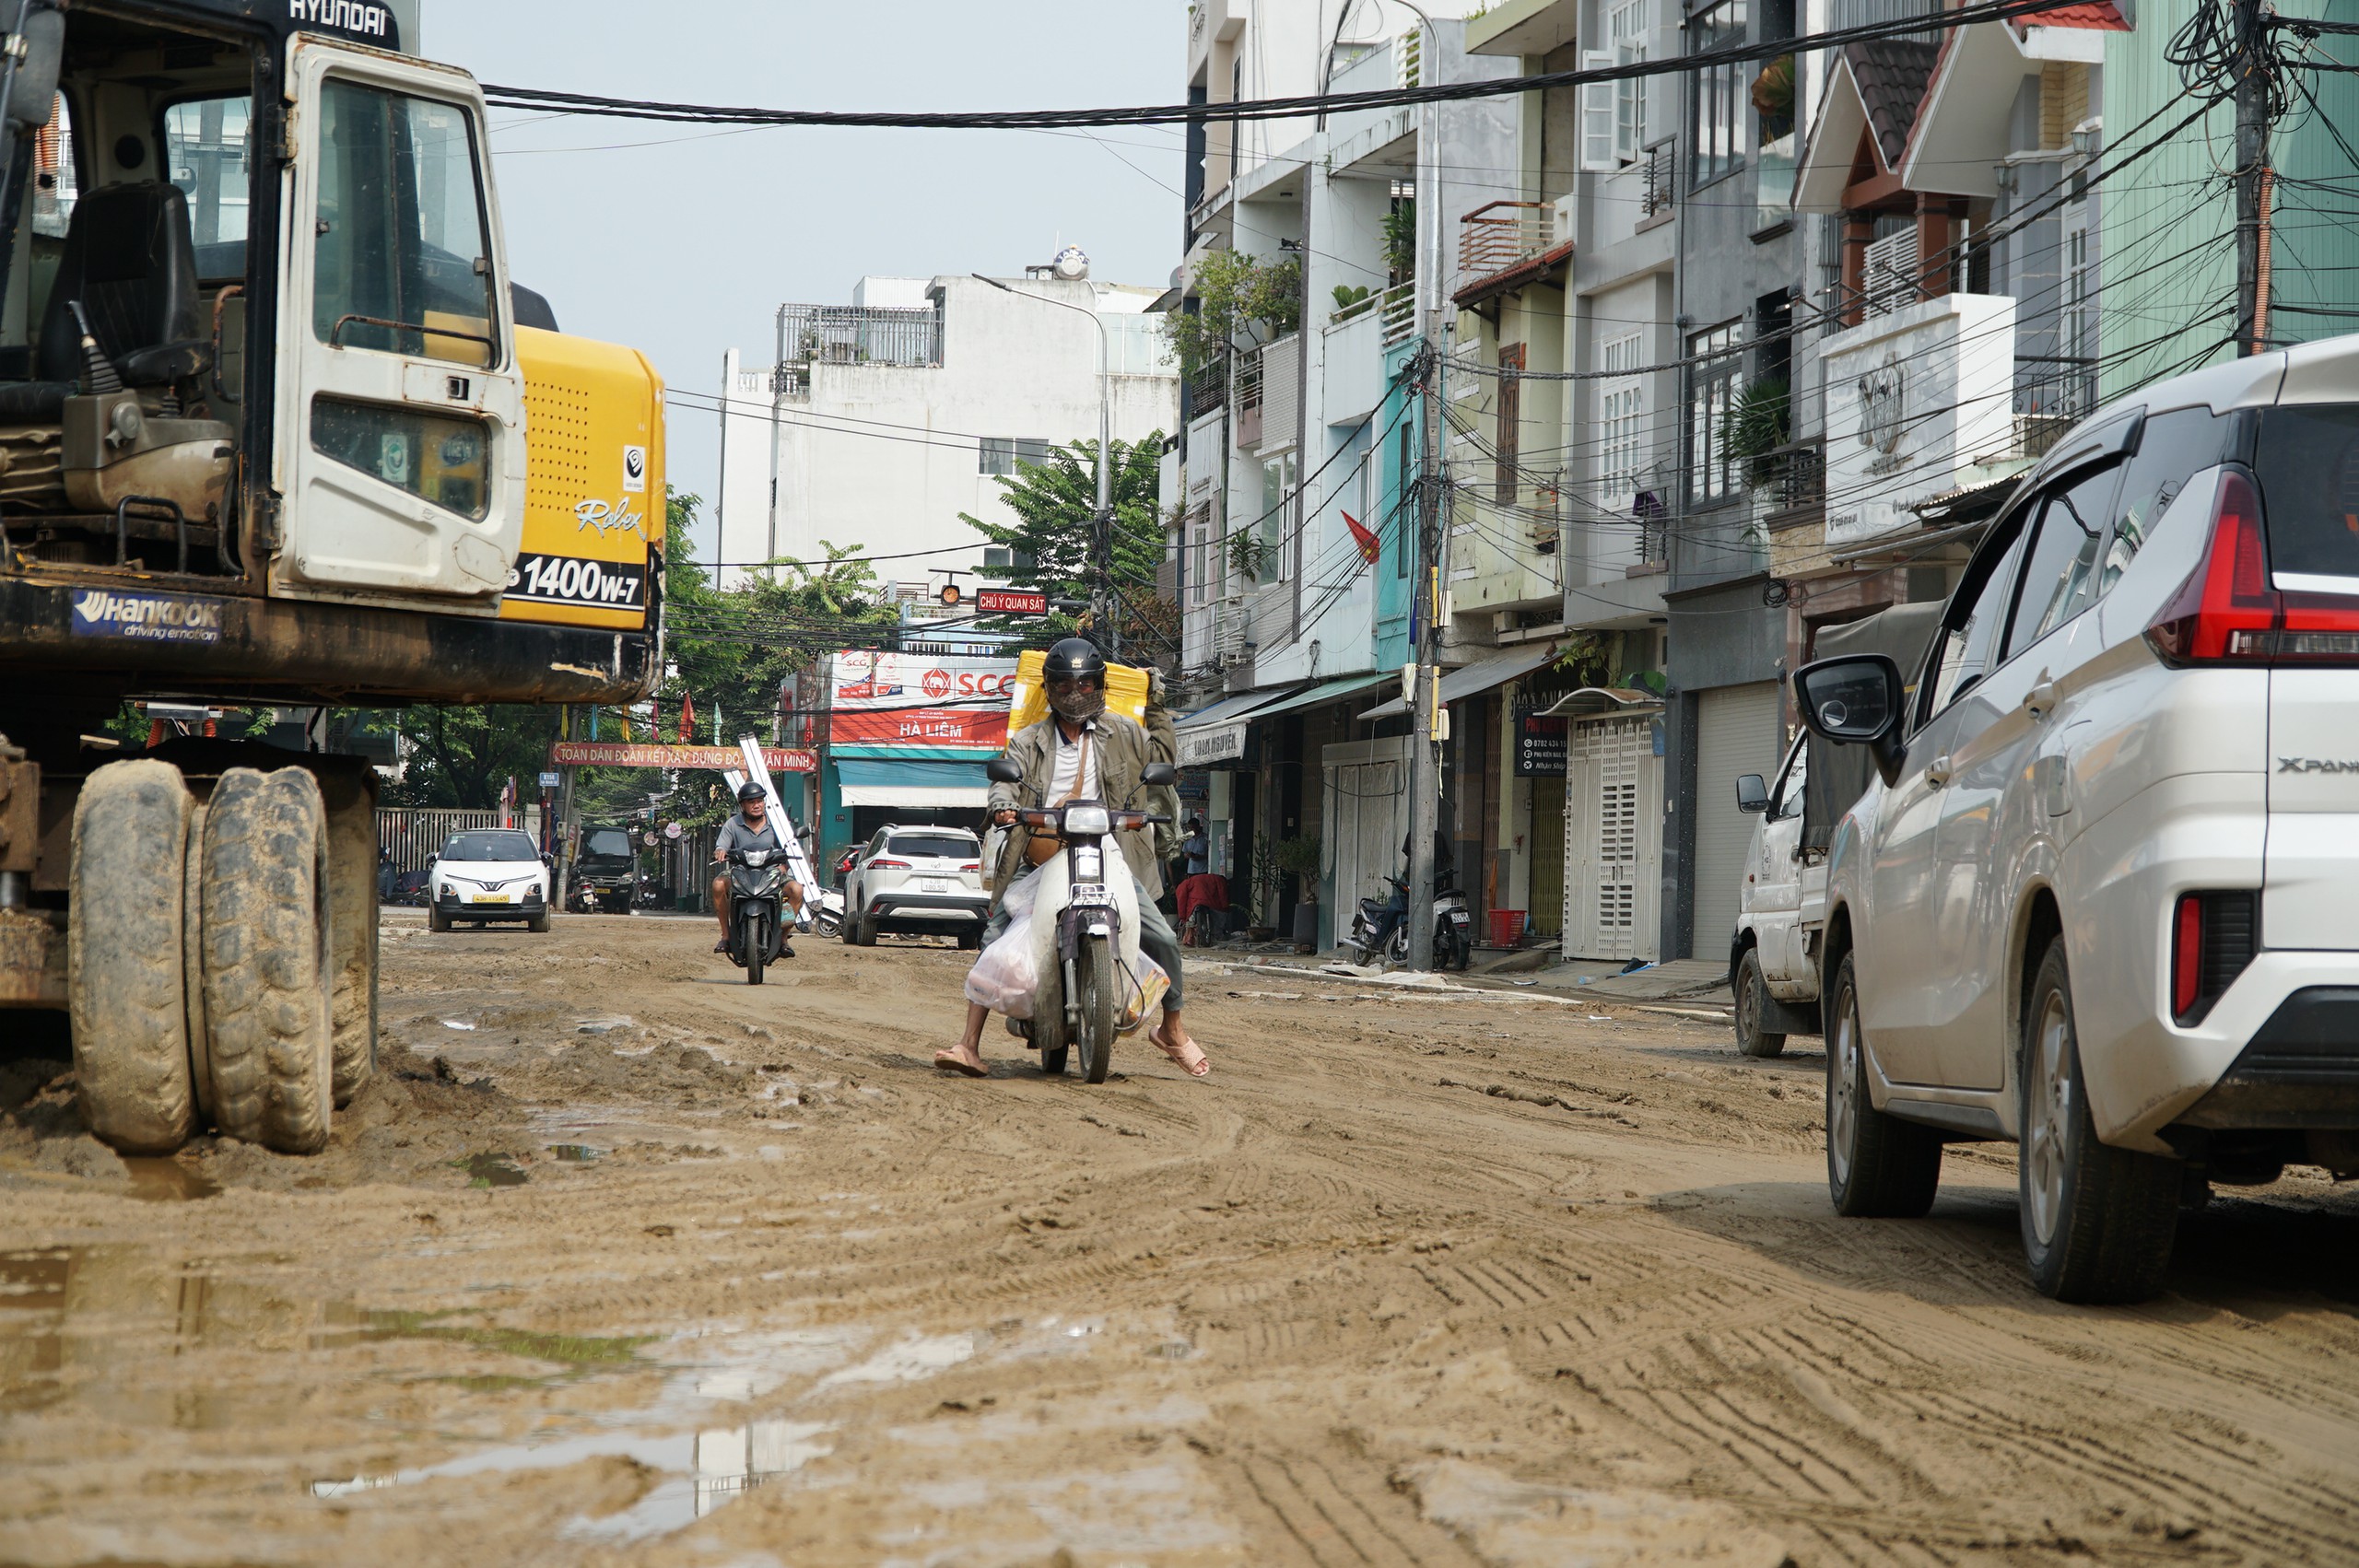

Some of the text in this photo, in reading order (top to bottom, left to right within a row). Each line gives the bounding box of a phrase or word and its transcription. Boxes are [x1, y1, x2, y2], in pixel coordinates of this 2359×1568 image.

[574, 496, 647, 542] Robex
[980, 594, 1045, 611] CHÚ Ý QUAN SÁT
[124, 624, 218, 641] driving emotion
[899, 720, 962, 737] HÀ LIÊM
[560, 746, 588, 761] TOÀN
[590, 747, 613, 762] DÂN
[615, 748, 644, 763] ĐOÀN
[647, 747, 665, 763] KẾT
[667, 749, 687, 764] XÂY
[692, 751, 723, 766] DỰNG
[725, 751, 740, 765] ĐÔ
[783, 755, 810, 767] MINH
[2277, 756, 2359, 773] XPAN
